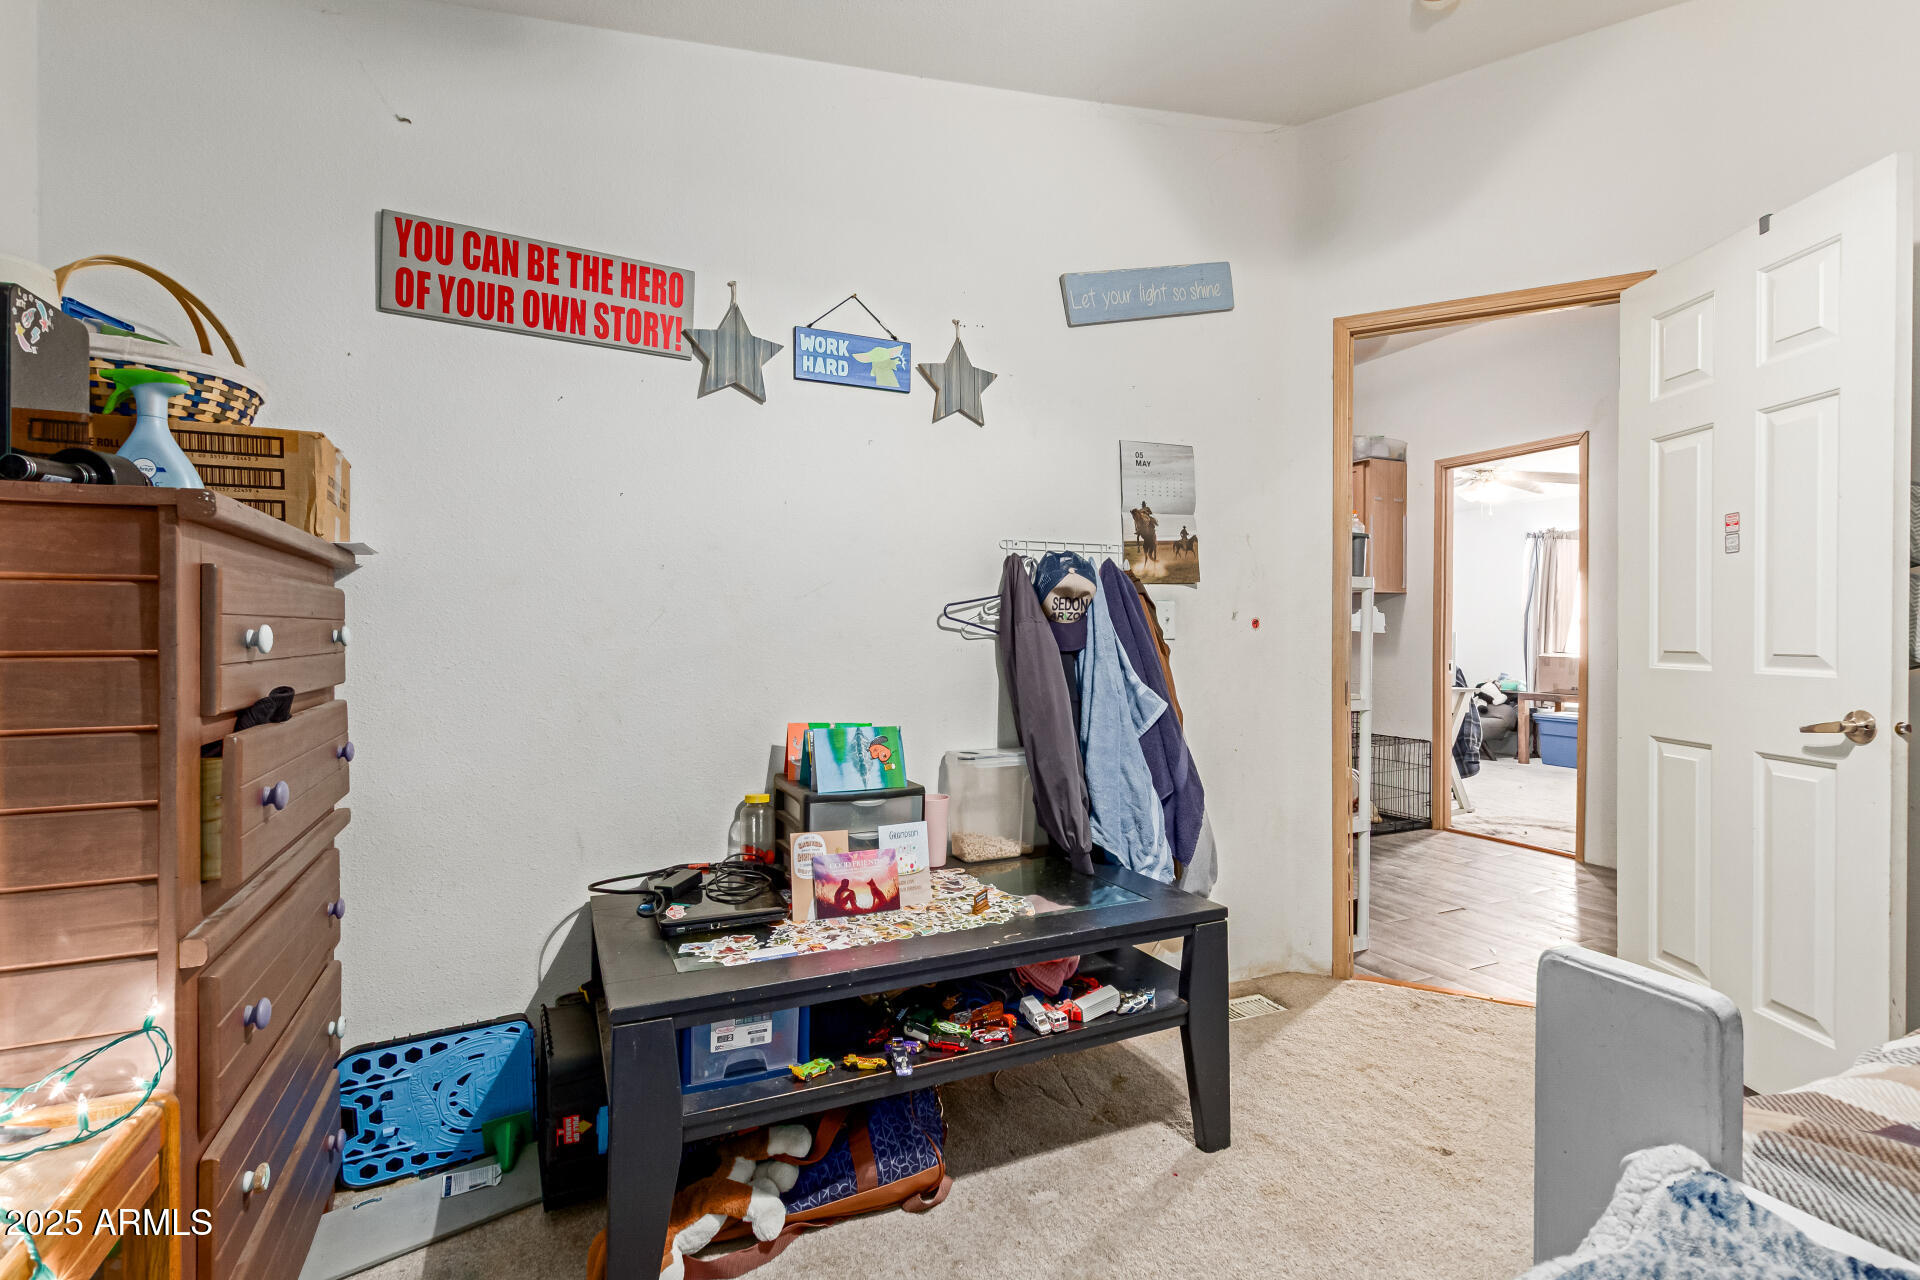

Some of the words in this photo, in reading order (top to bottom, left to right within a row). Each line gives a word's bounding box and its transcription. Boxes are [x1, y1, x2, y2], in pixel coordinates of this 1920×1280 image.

[394, 217, 454, 266] YOU
[462, 231, 519, 278] CAN
[527, 243, 560, 286] BE
[566, 251, 614, 296] THE
[620, 262, 684, 309] HERO
[1069, 288, 1096, 310] Let
[1102, 288, 1132, 310] your
[1139, 281, 1168, 306] light
[1173, 287, 1186, 300] so
[1189, 281, 1222, 300] shine
[394, 267, 431, 310] OF
[437, 274, 515, 324] YOUR
[522, 289, 587, 336] OWN
[593, 302, 683, 352] STORY!
[800, 333, 850, 357] WORK
[802, 355, 849, 377] HARD
[1135, 451, 1144, 459] 05
[1052, 597, 1091, 612] SEDON
